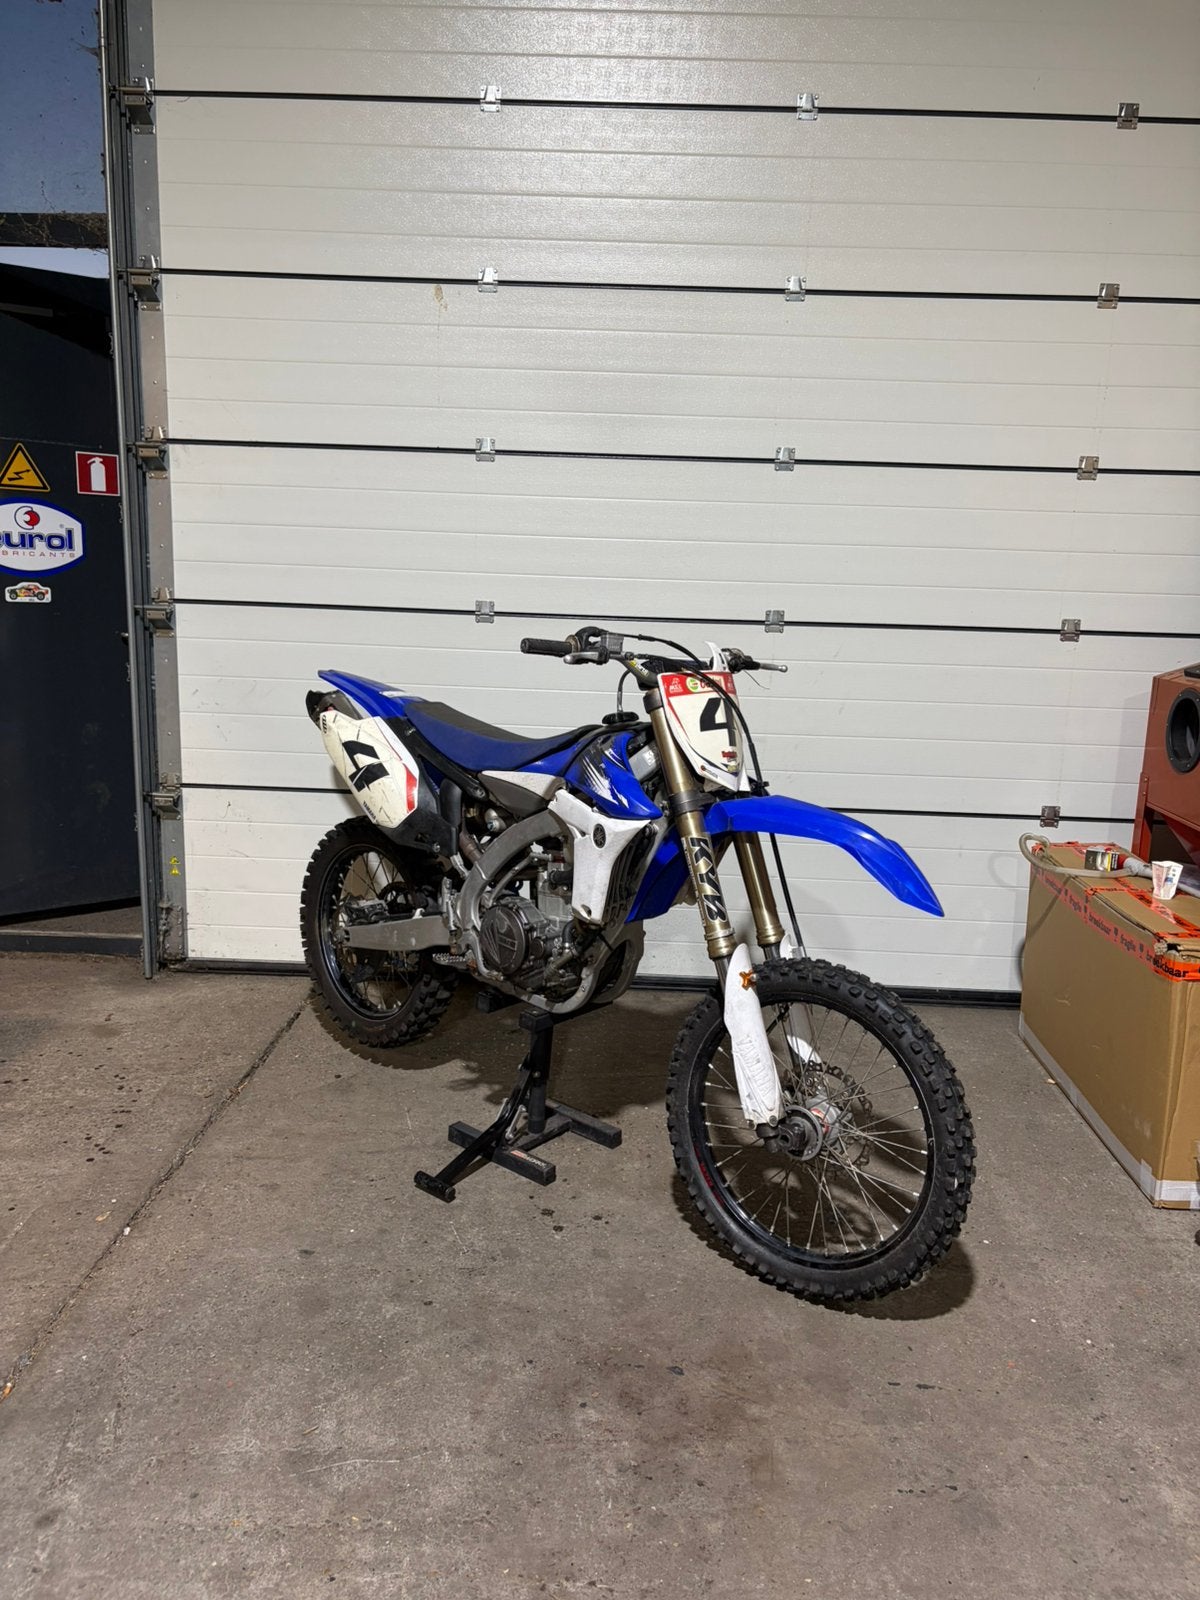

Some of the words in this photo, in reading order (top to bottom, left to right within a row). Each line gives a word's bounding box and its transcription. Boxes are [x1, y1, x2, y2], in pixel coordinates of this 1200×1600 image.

[0, 528, 75, 551] urol
[699, 697, 737, 747] 4
[342, 740, 390, 793] 4
[689, 836, 727, 922] KYB
